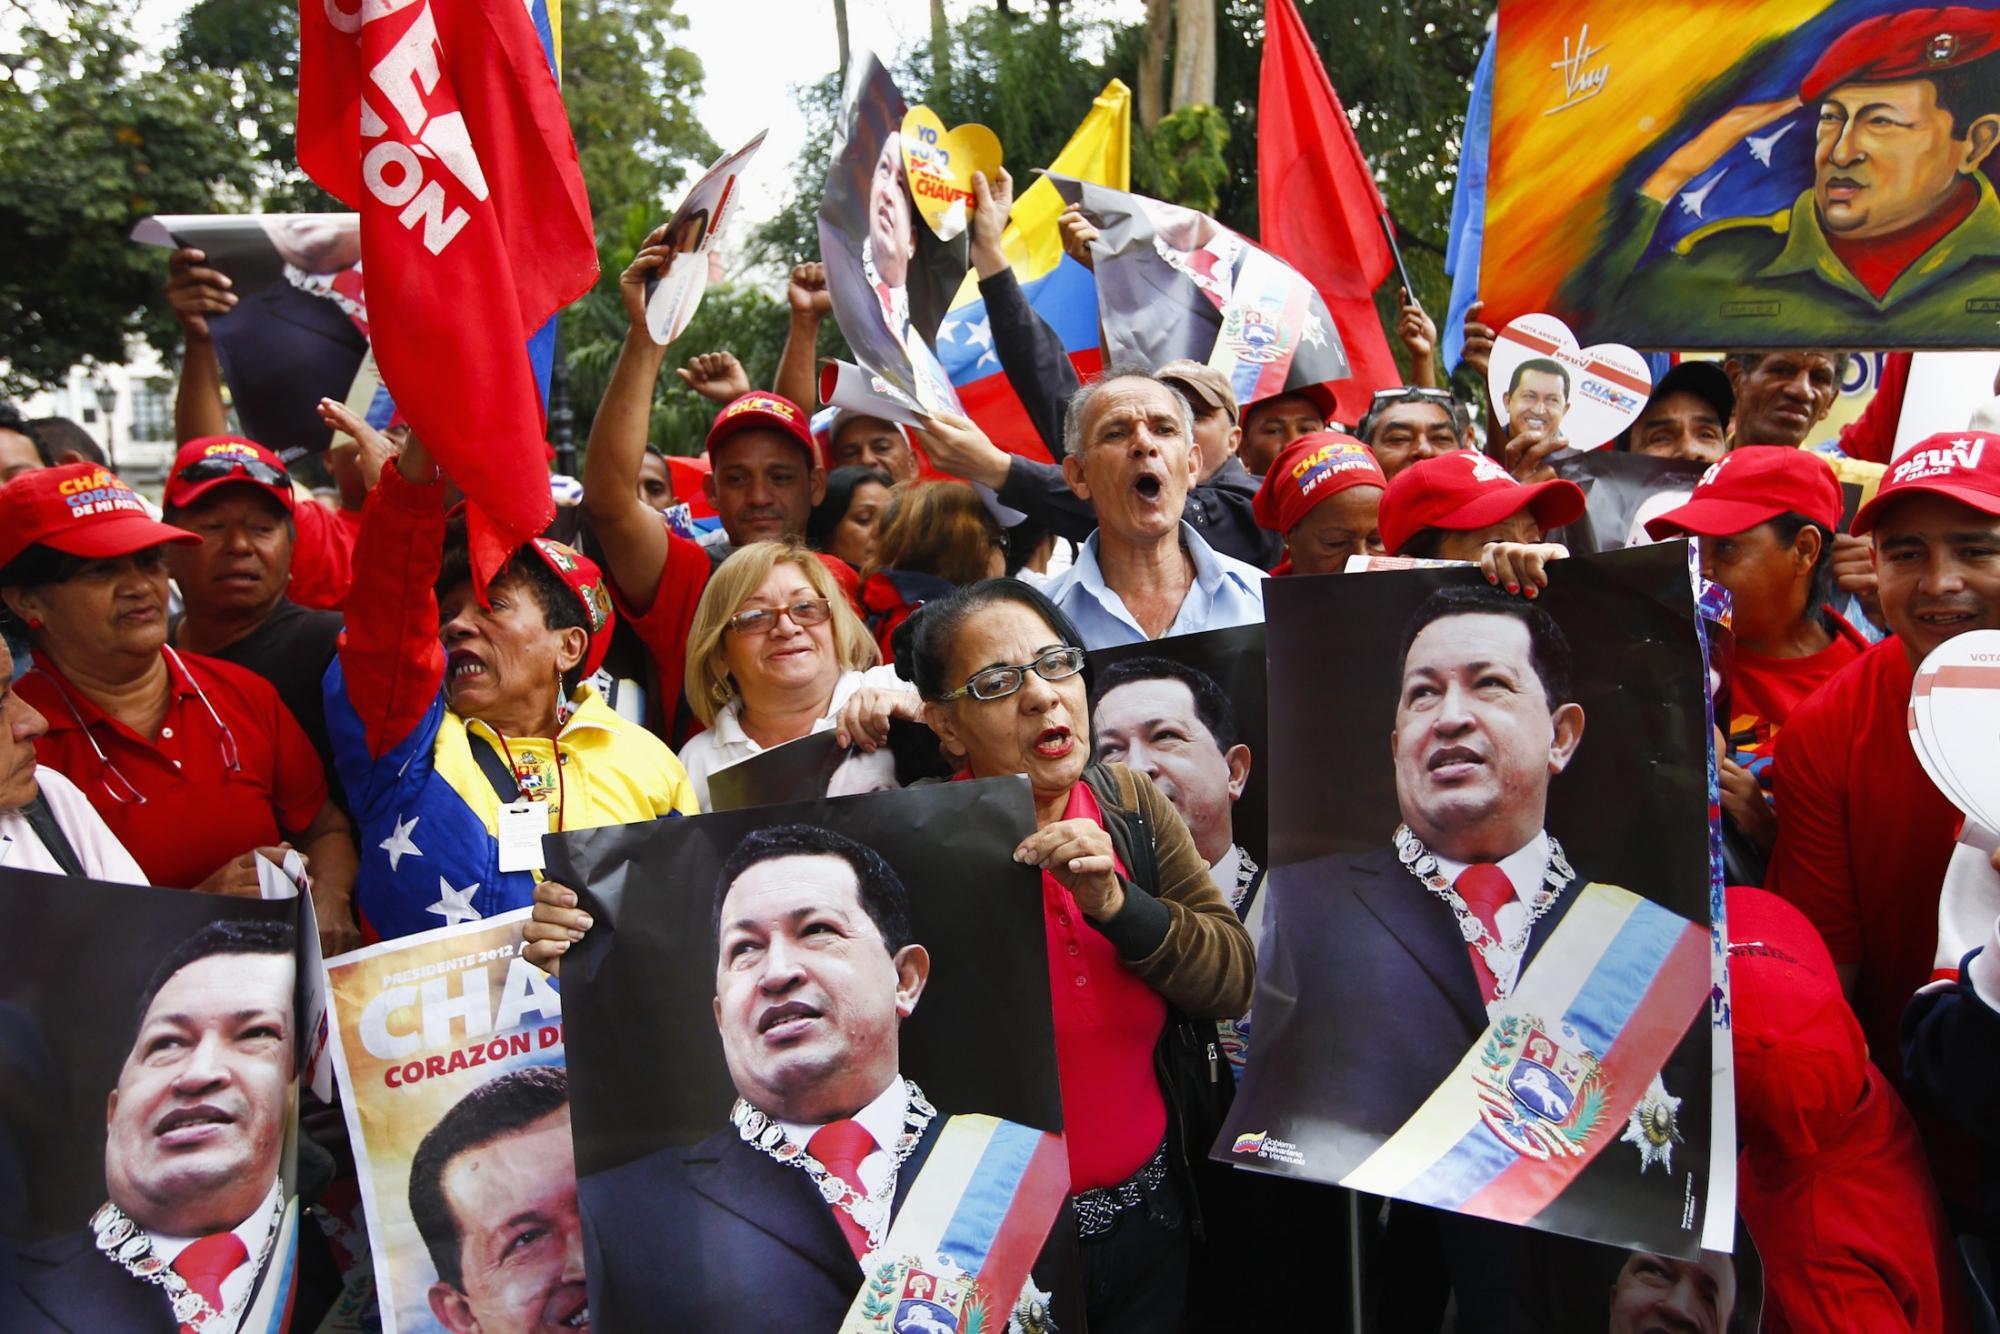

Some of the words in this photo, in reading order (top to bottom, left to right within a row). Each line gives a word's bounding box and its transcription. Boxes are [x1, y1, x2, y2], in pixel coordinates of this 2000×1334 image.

[917, 125, 938, 145] YO
[1317, 468, 1332, 483] MI
[72, 503, 94, 518] DE
[95, 500, 113, 513] MI
[382, 956, 476, 989] PRESIDENTE
[478, 945, 513, 963] 2012
[384, 1031, 530, 1089] CORAZÓN
[538, 1023, 566, 1049] D
[1264, 1136, 1297, 1150] Gobierno
[1257, 1150, 1268, 1158] de
